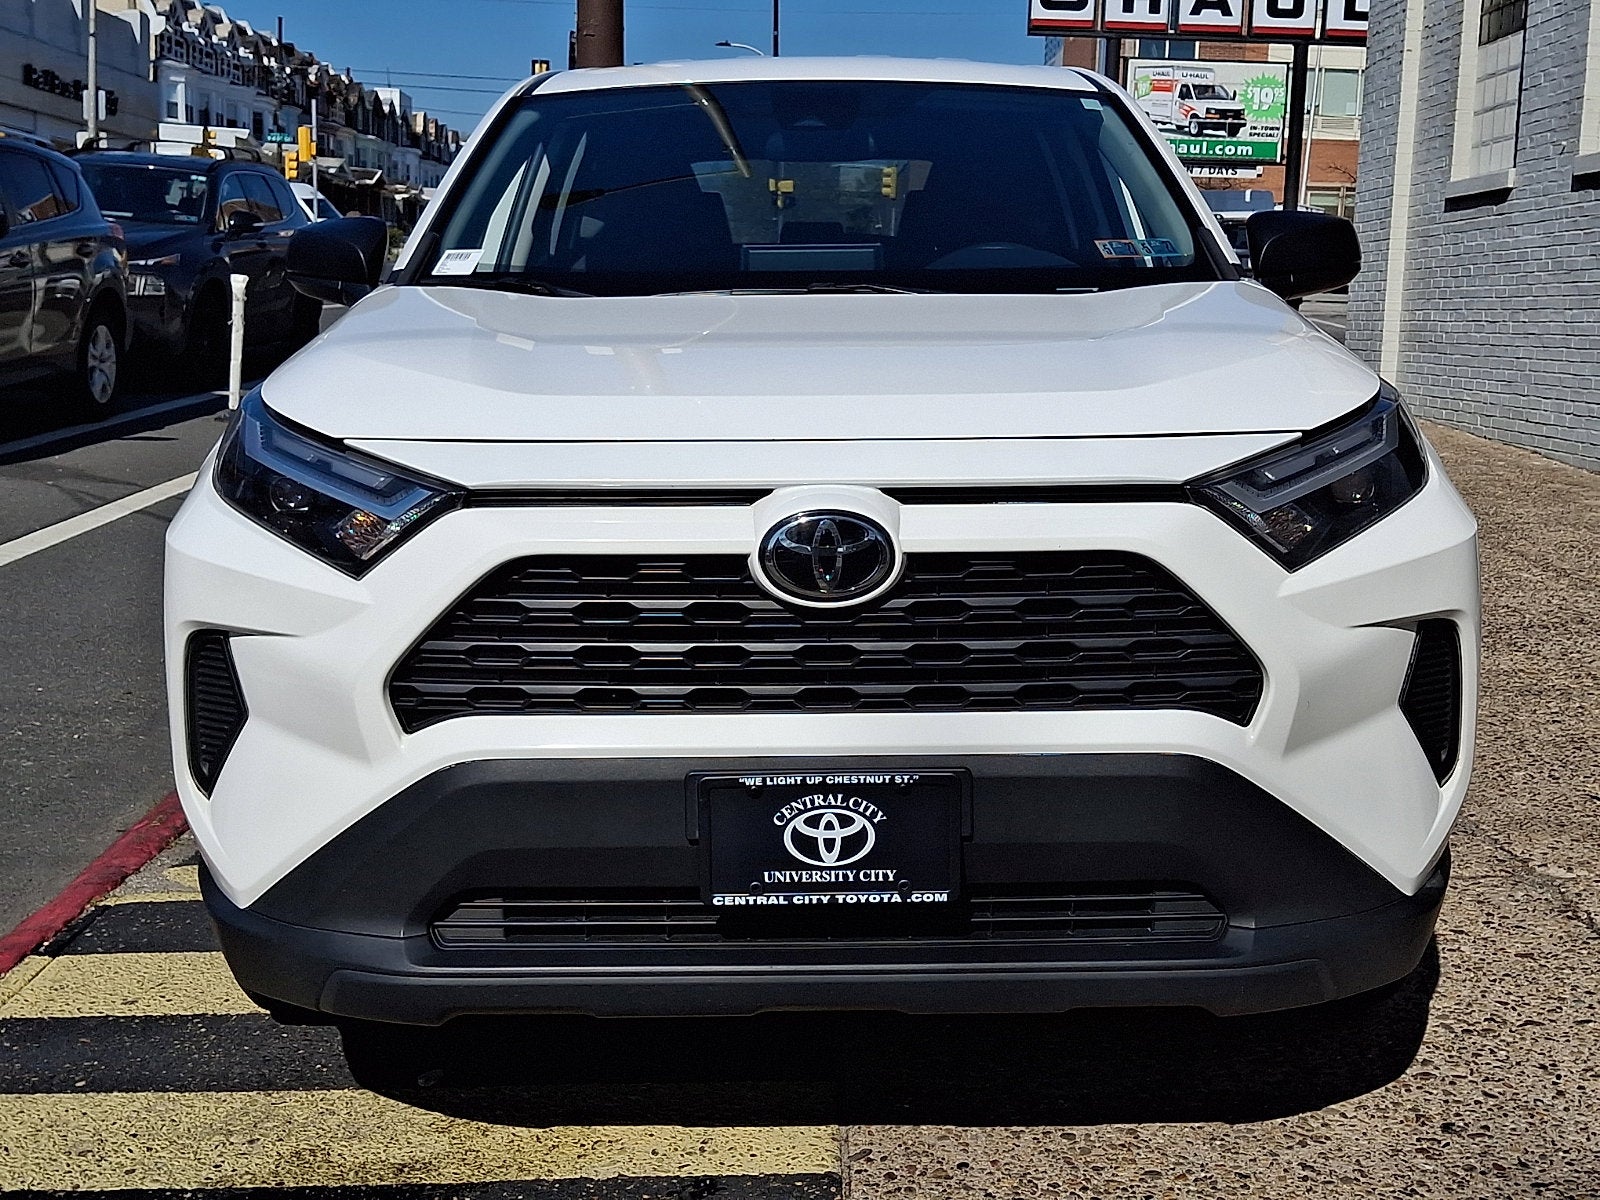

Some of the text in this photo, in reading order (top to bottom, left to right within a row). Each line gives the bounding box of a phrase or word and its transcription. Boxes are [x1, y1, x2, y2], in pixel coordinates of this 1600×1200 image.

[1208, 166, 1238, 176] DAYS
[766, 776, 803, 786] LIGHT
[806, 776, 823, 785] UP
[825, 775, 891, 785] CHESTNUT
[773, 793, 887, 826] CENTRAL CITY
[763, 869, 897, 883] UNIVERSITY CITY
[712, 893, 948, 906] CENTRAL CITY TOYOTA .COM
